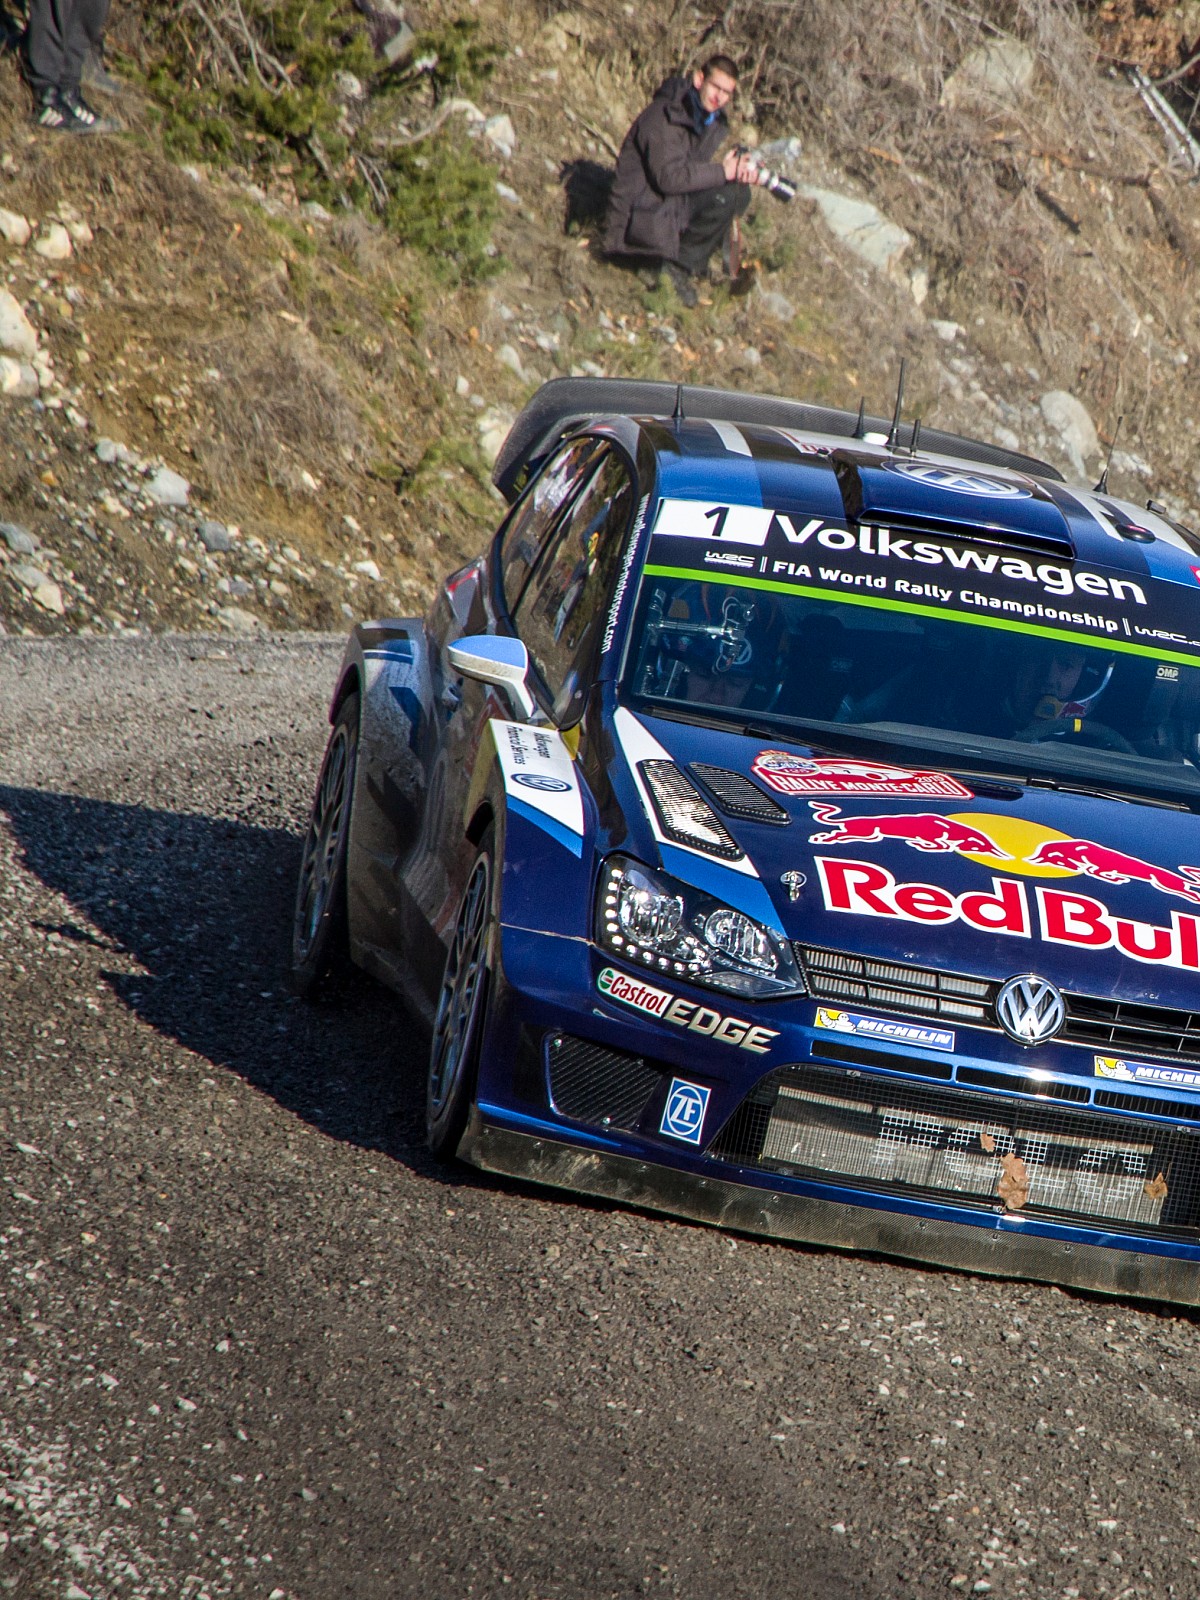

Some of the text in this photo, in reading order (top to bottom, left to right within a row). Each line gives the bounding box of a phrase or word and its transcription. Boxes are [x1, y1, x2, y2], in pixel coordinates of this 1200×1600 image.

[704, 506, 730, 538] 1
[776, 514, 1148, 605] Volkswagen
[772, 560, 812, 578] FIA
[818, 567, 887, 589] World
[894, 580, 953, 602] Rally
[959, 590, 1119, 633] Championship
[1156, 666, 1179, 678] OMP
[769, 774, 963, 797] RALLYE MONTE-CARLO
[914, 773, 946, 785] 2015
[818, 858, 1027, 936] Red
[610, 976, 782, 1055] Castrol EDGE
[997, 973, 1066, 1047] VW
[856, 1018, 952, 1045] MICHELIN
[669, 1091, 703, 1130] ZF
